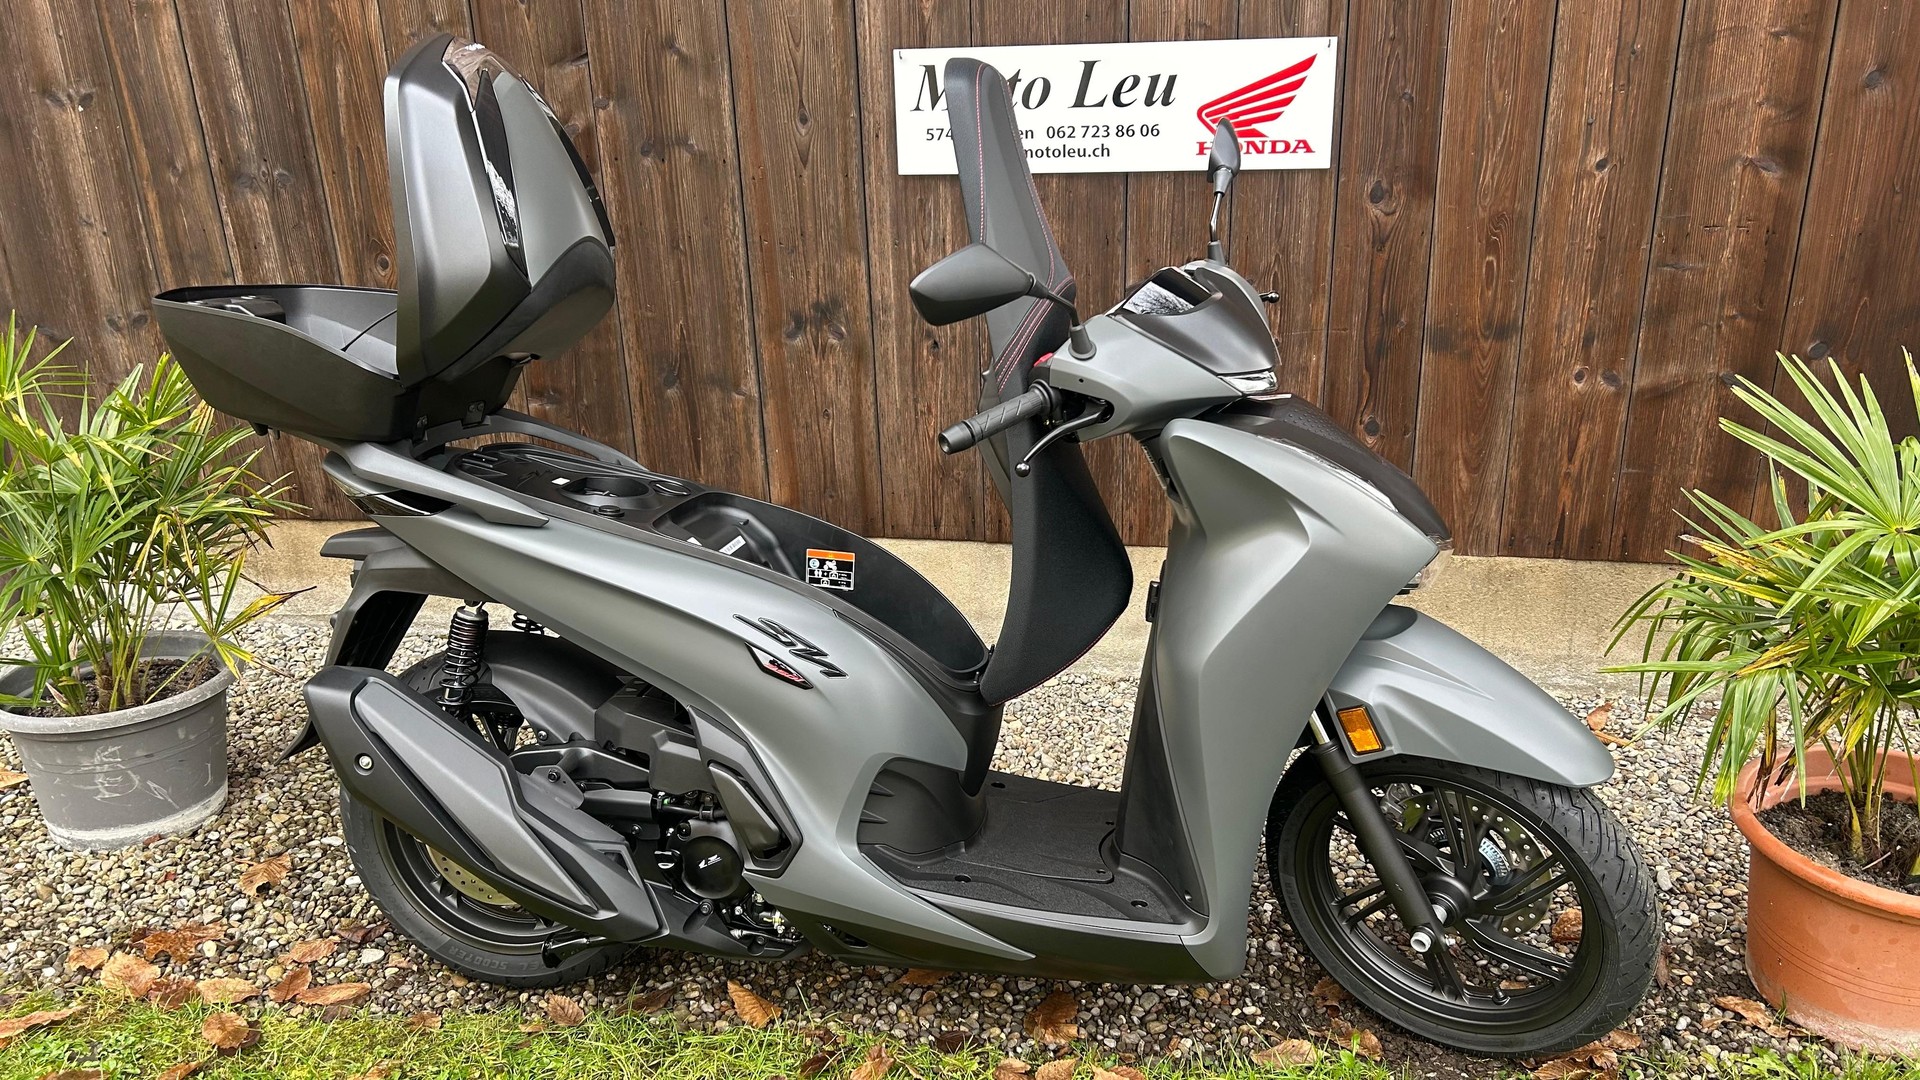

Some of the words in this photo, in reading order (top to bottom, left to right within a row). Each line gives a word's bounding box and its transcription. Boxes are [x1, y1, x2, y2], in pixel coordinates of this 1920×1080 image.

[910, 64, 1051, 111] Mto
[1067, 60, 1178, 108] Leu
[926, 127, 953, 141] 574
[1046, 125, 1076, 139] 062
[1081, 125, 1110, 138] 723
[1115, 124, 1135, 138] 86
[1140, 123, 1160, 137] 06
[1023, 143, 1110, 159] motoleu.ch
[1196, 139, 1315, 155] HNDA
